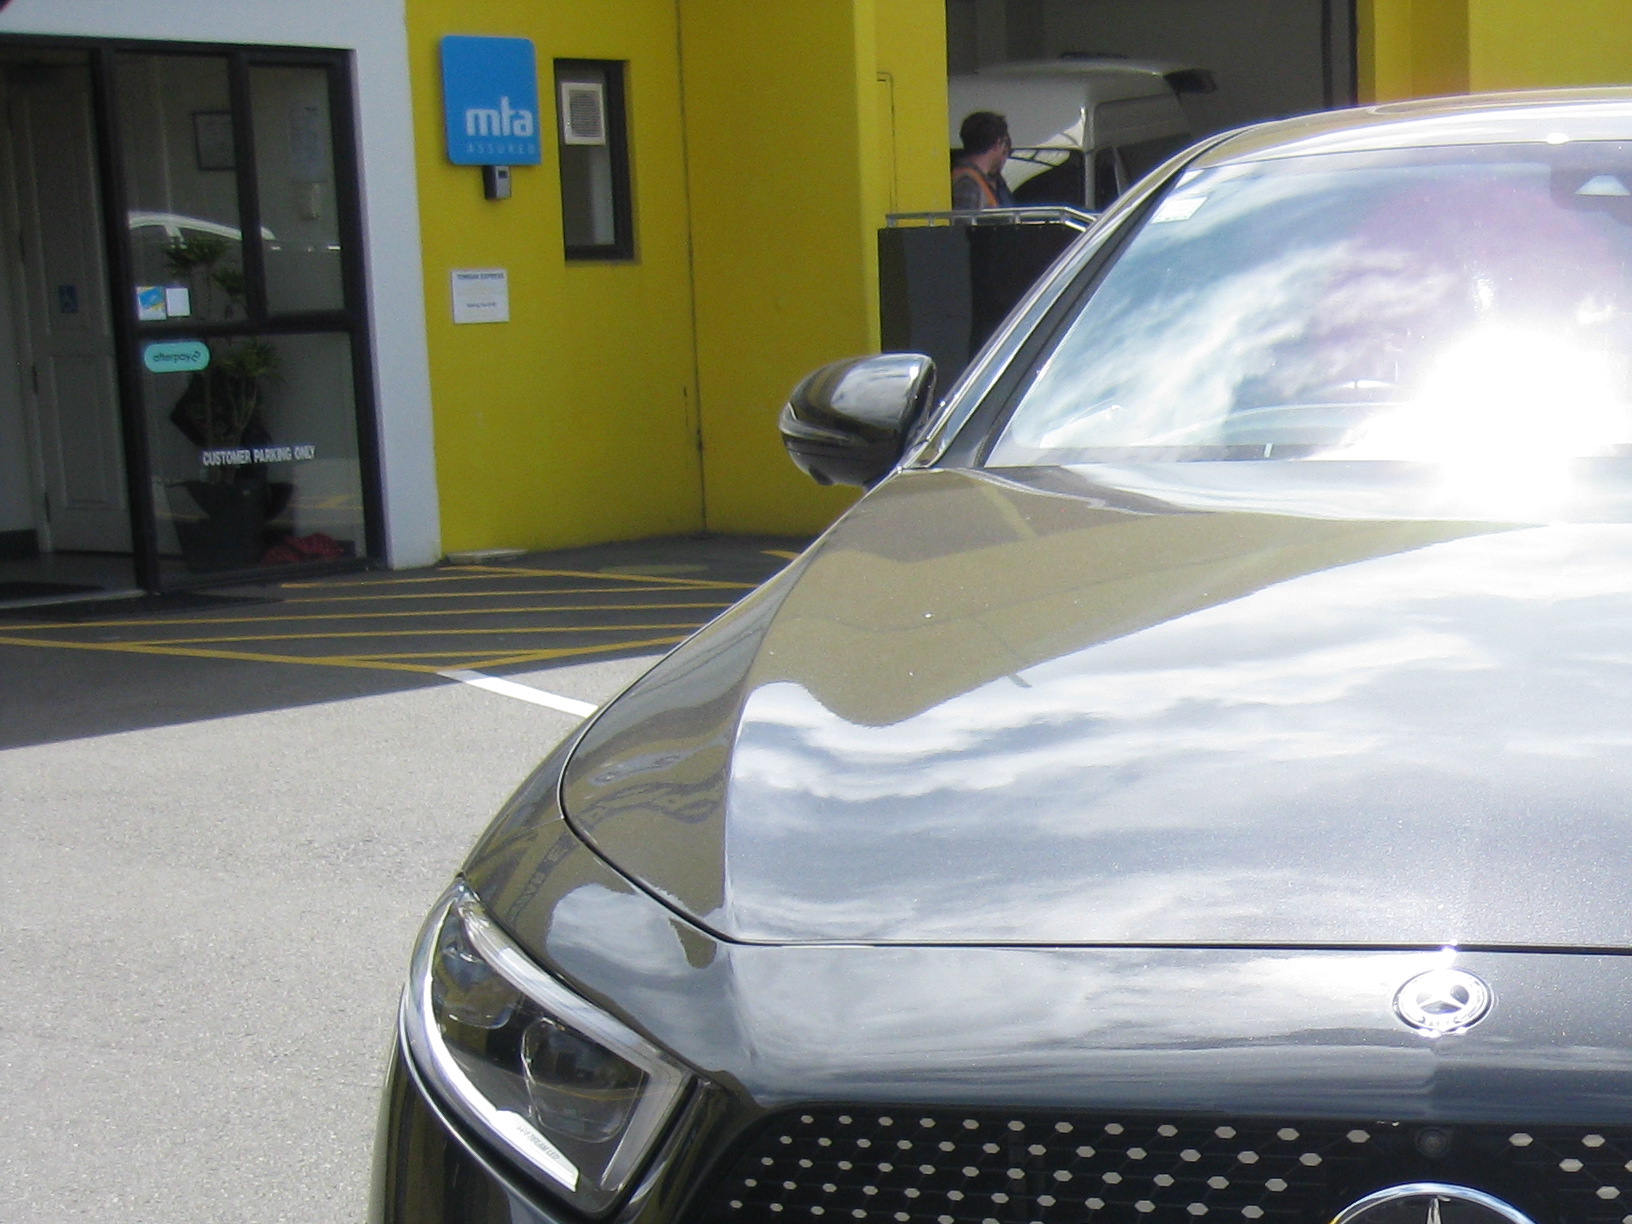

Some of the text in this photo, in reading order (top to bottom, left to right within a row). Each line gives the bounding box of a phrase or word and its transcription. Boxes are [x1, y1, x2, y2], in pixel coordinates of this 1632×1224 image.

[466, 96, 533, 137] mta
[203, 445, 316, 466] CUSTOMER PARKING ONLY
